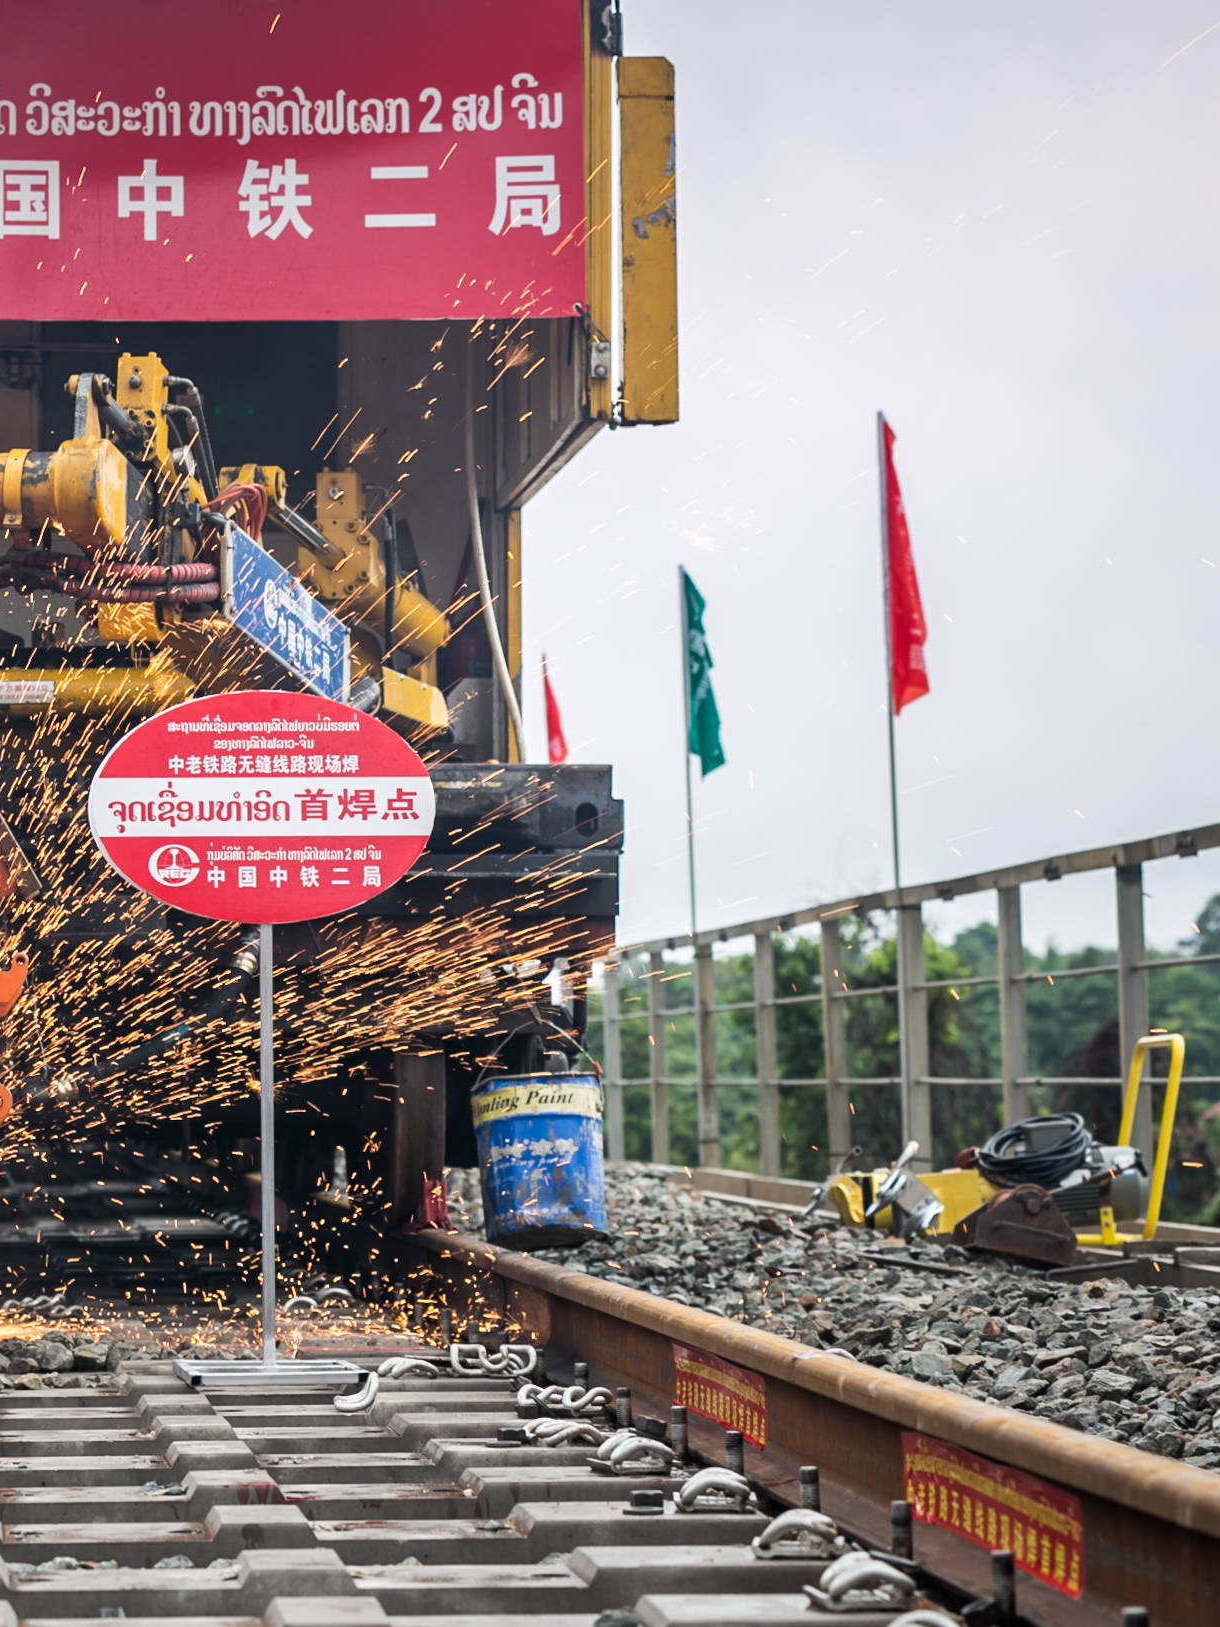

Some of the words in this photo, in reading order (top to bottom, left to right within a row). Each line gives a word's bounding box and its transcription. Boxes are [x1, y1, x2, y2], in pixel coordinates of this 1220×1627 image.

[189, 85, 410, 145] ທາງລົດໄຟເລກ
[418, 87, 442, 133] 2
[452, 84, 504, 132] ສປ
[511, 72, 563, 130] ຈີນ
[168, 755, 360, 774] 中老铁路无缝线路现场焊
[294, 788, 420, 821] 首焊点
[345, 850, 352, 860] 2
[207, 866, 382, 888] 中国中铁二局
[526, 1090, 574, 1105] Paint
